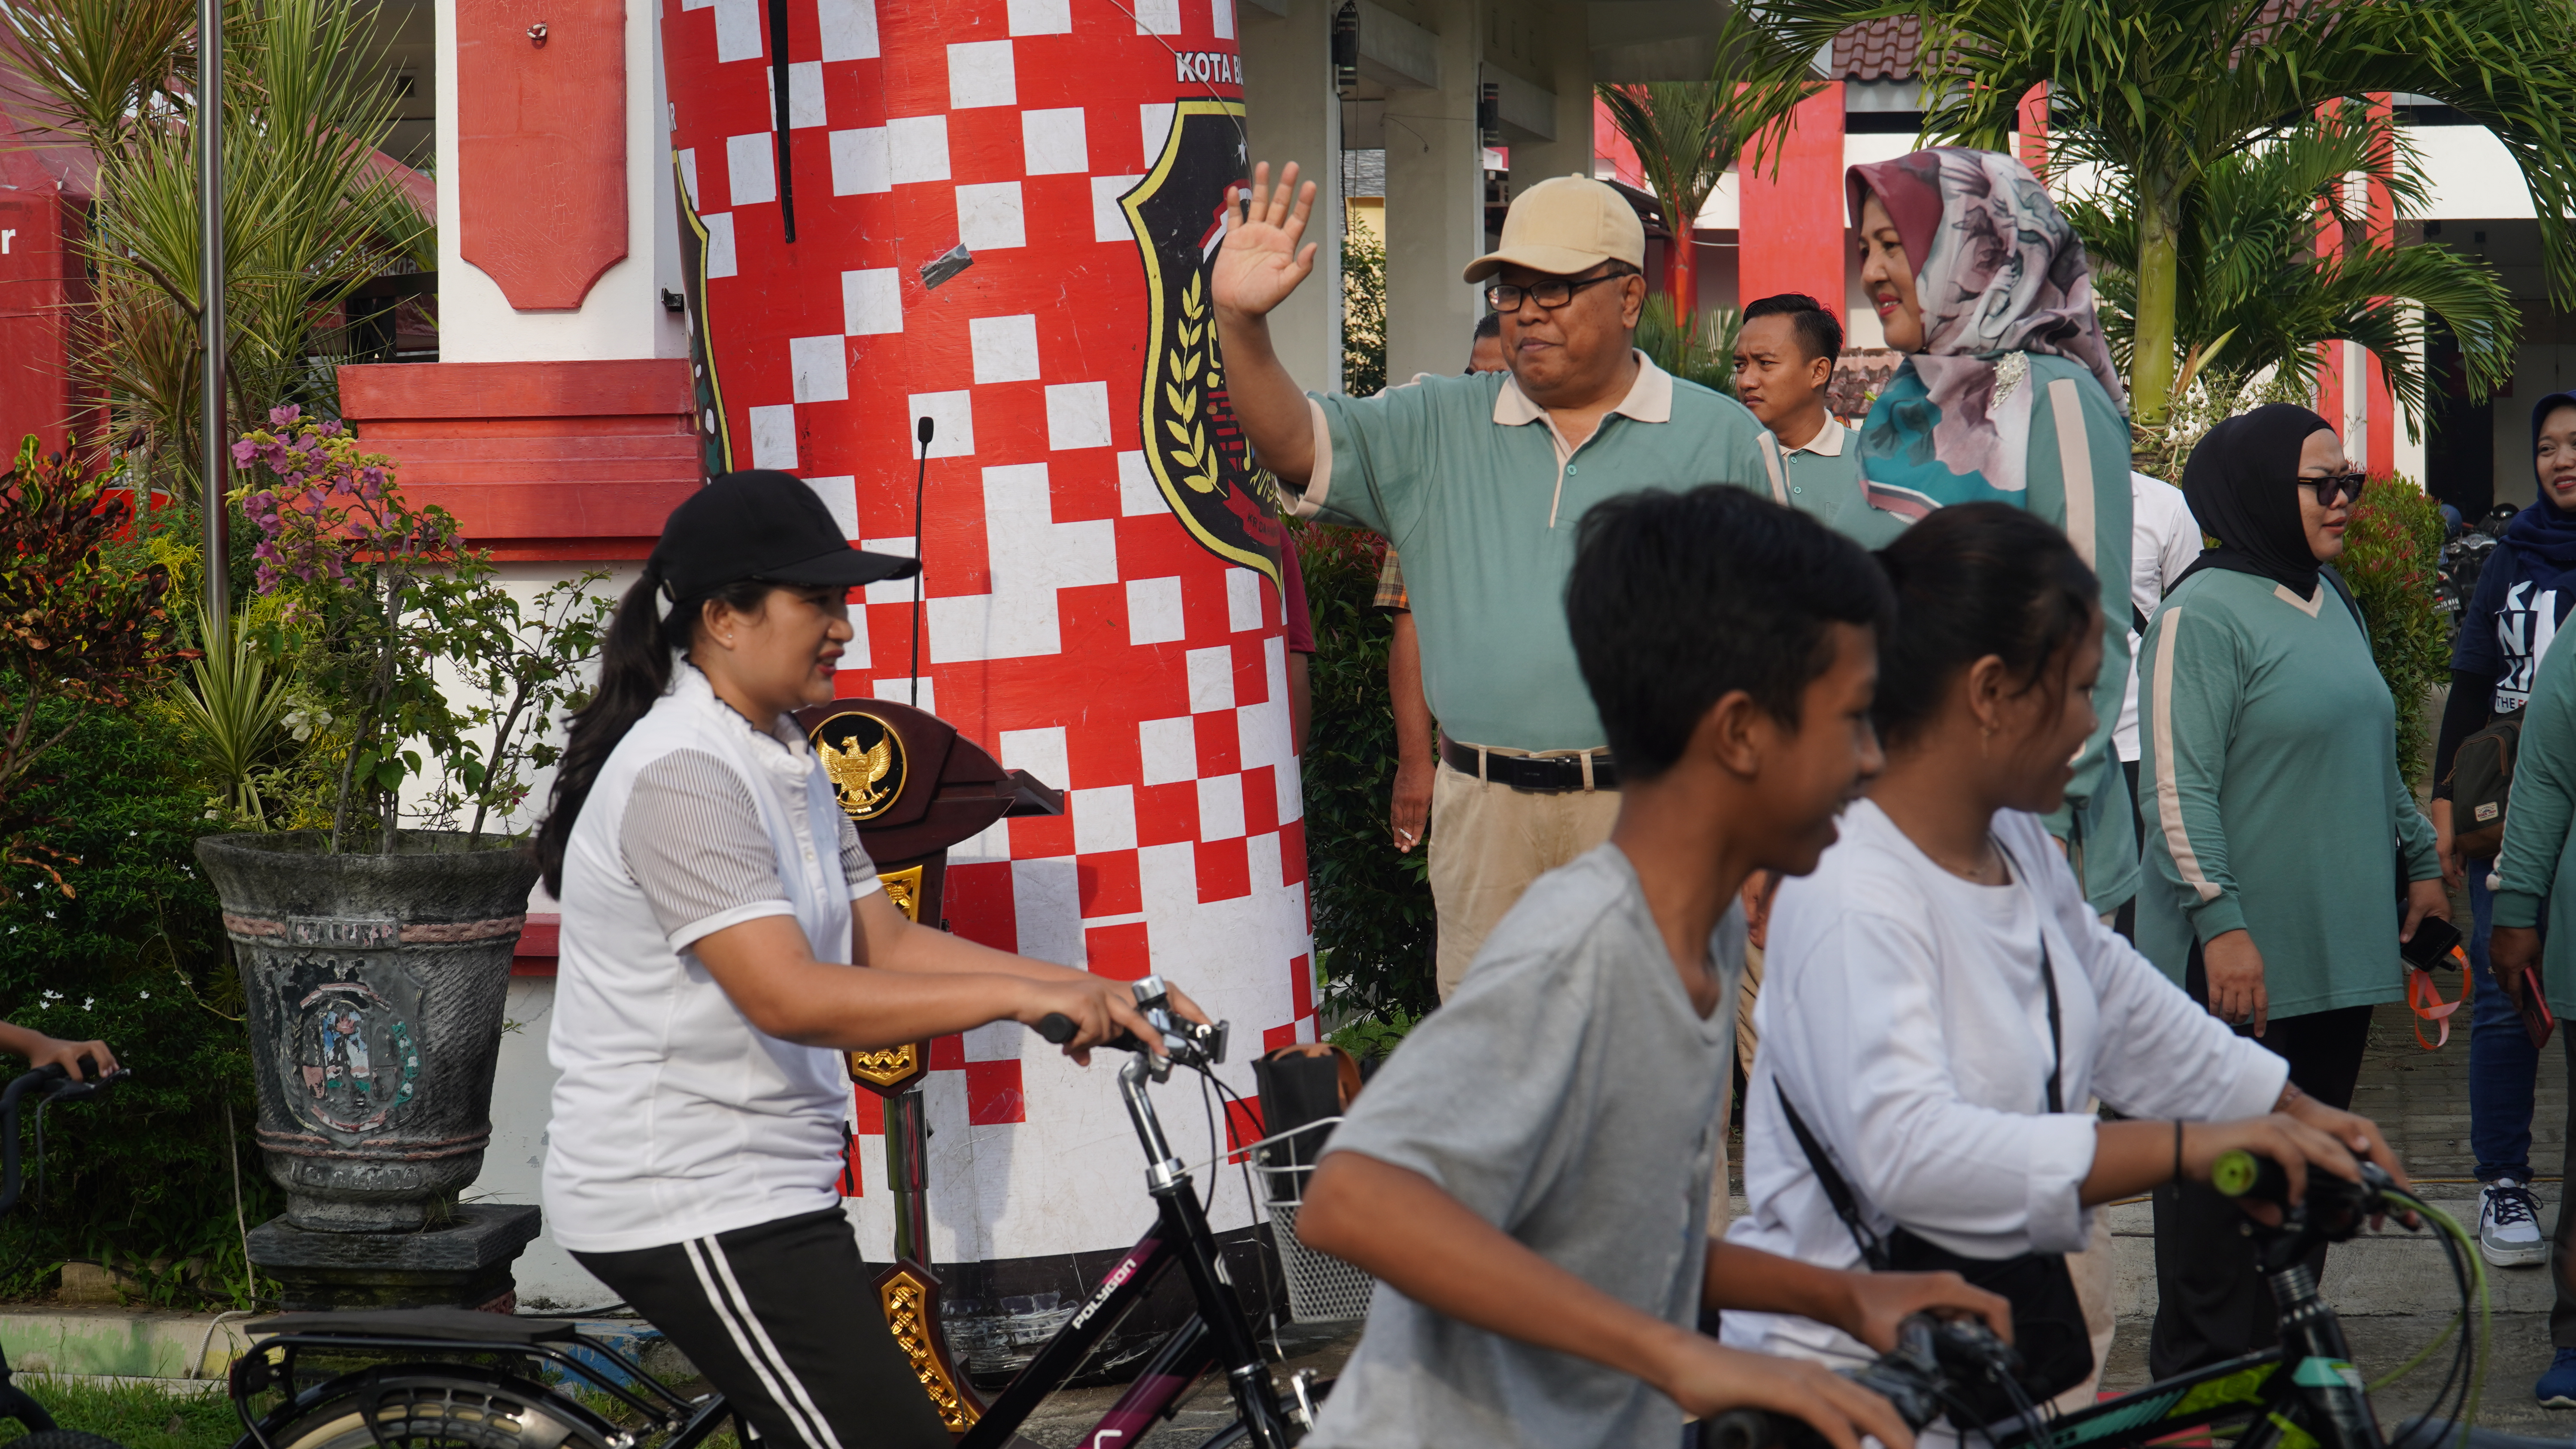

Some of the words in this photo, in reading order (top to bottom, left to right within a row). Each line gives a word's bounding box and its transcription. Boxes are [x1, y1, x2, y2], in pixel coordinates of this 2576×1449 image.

[1176, 52, 1232, 83] KOTA
[2497, 695, 2515, 709] THE
[1072, 1258, 1136, 1330] POLYGON
